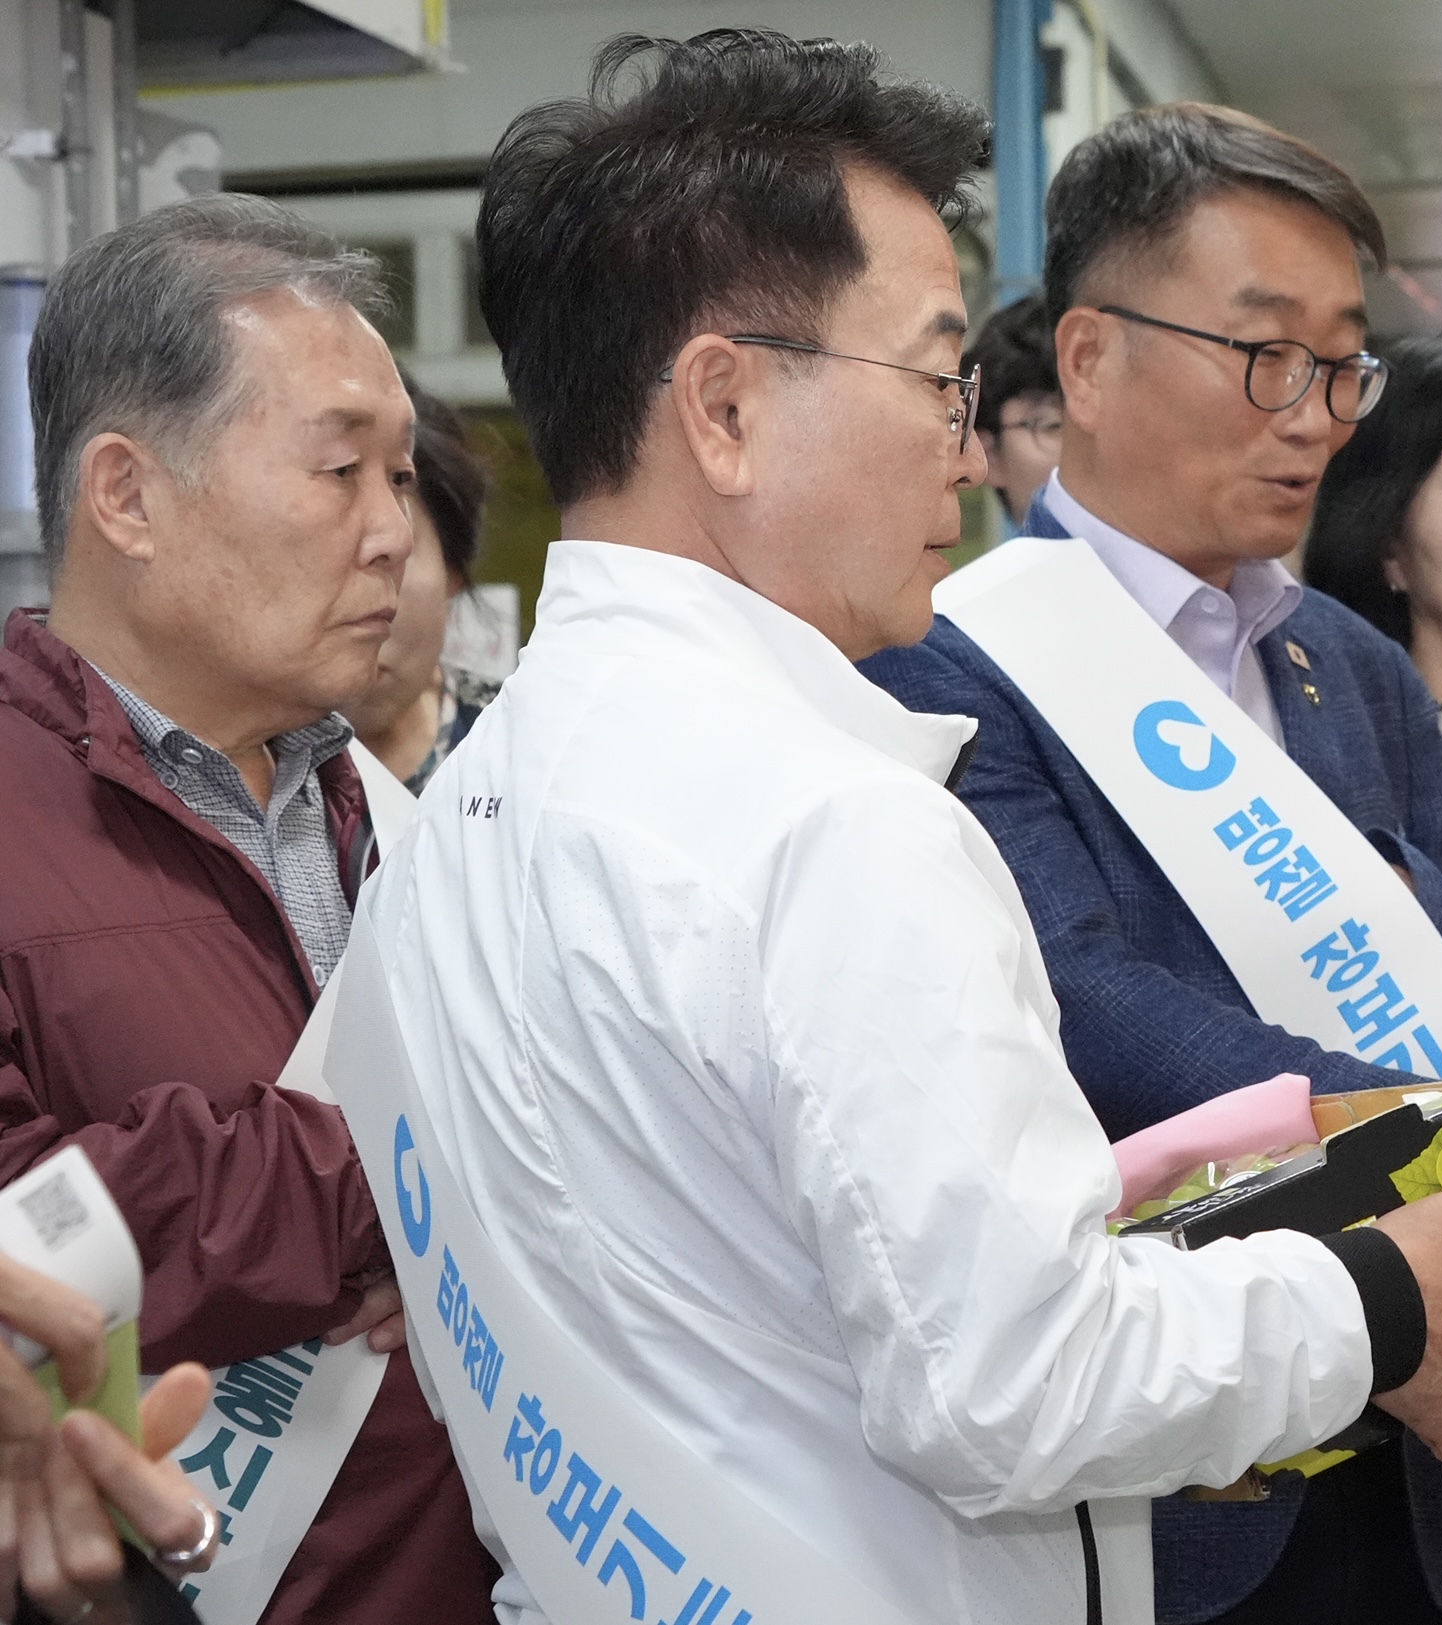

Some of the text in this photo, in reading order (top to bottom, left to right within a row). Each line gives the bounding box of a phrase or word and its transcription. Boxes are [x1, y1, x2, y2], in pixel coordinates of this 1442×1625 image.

[1213, 796, 1339, 923] 명절
[436, 1243, 505, 1414] 명절
[178, 1337, 324, 1572] 통시
